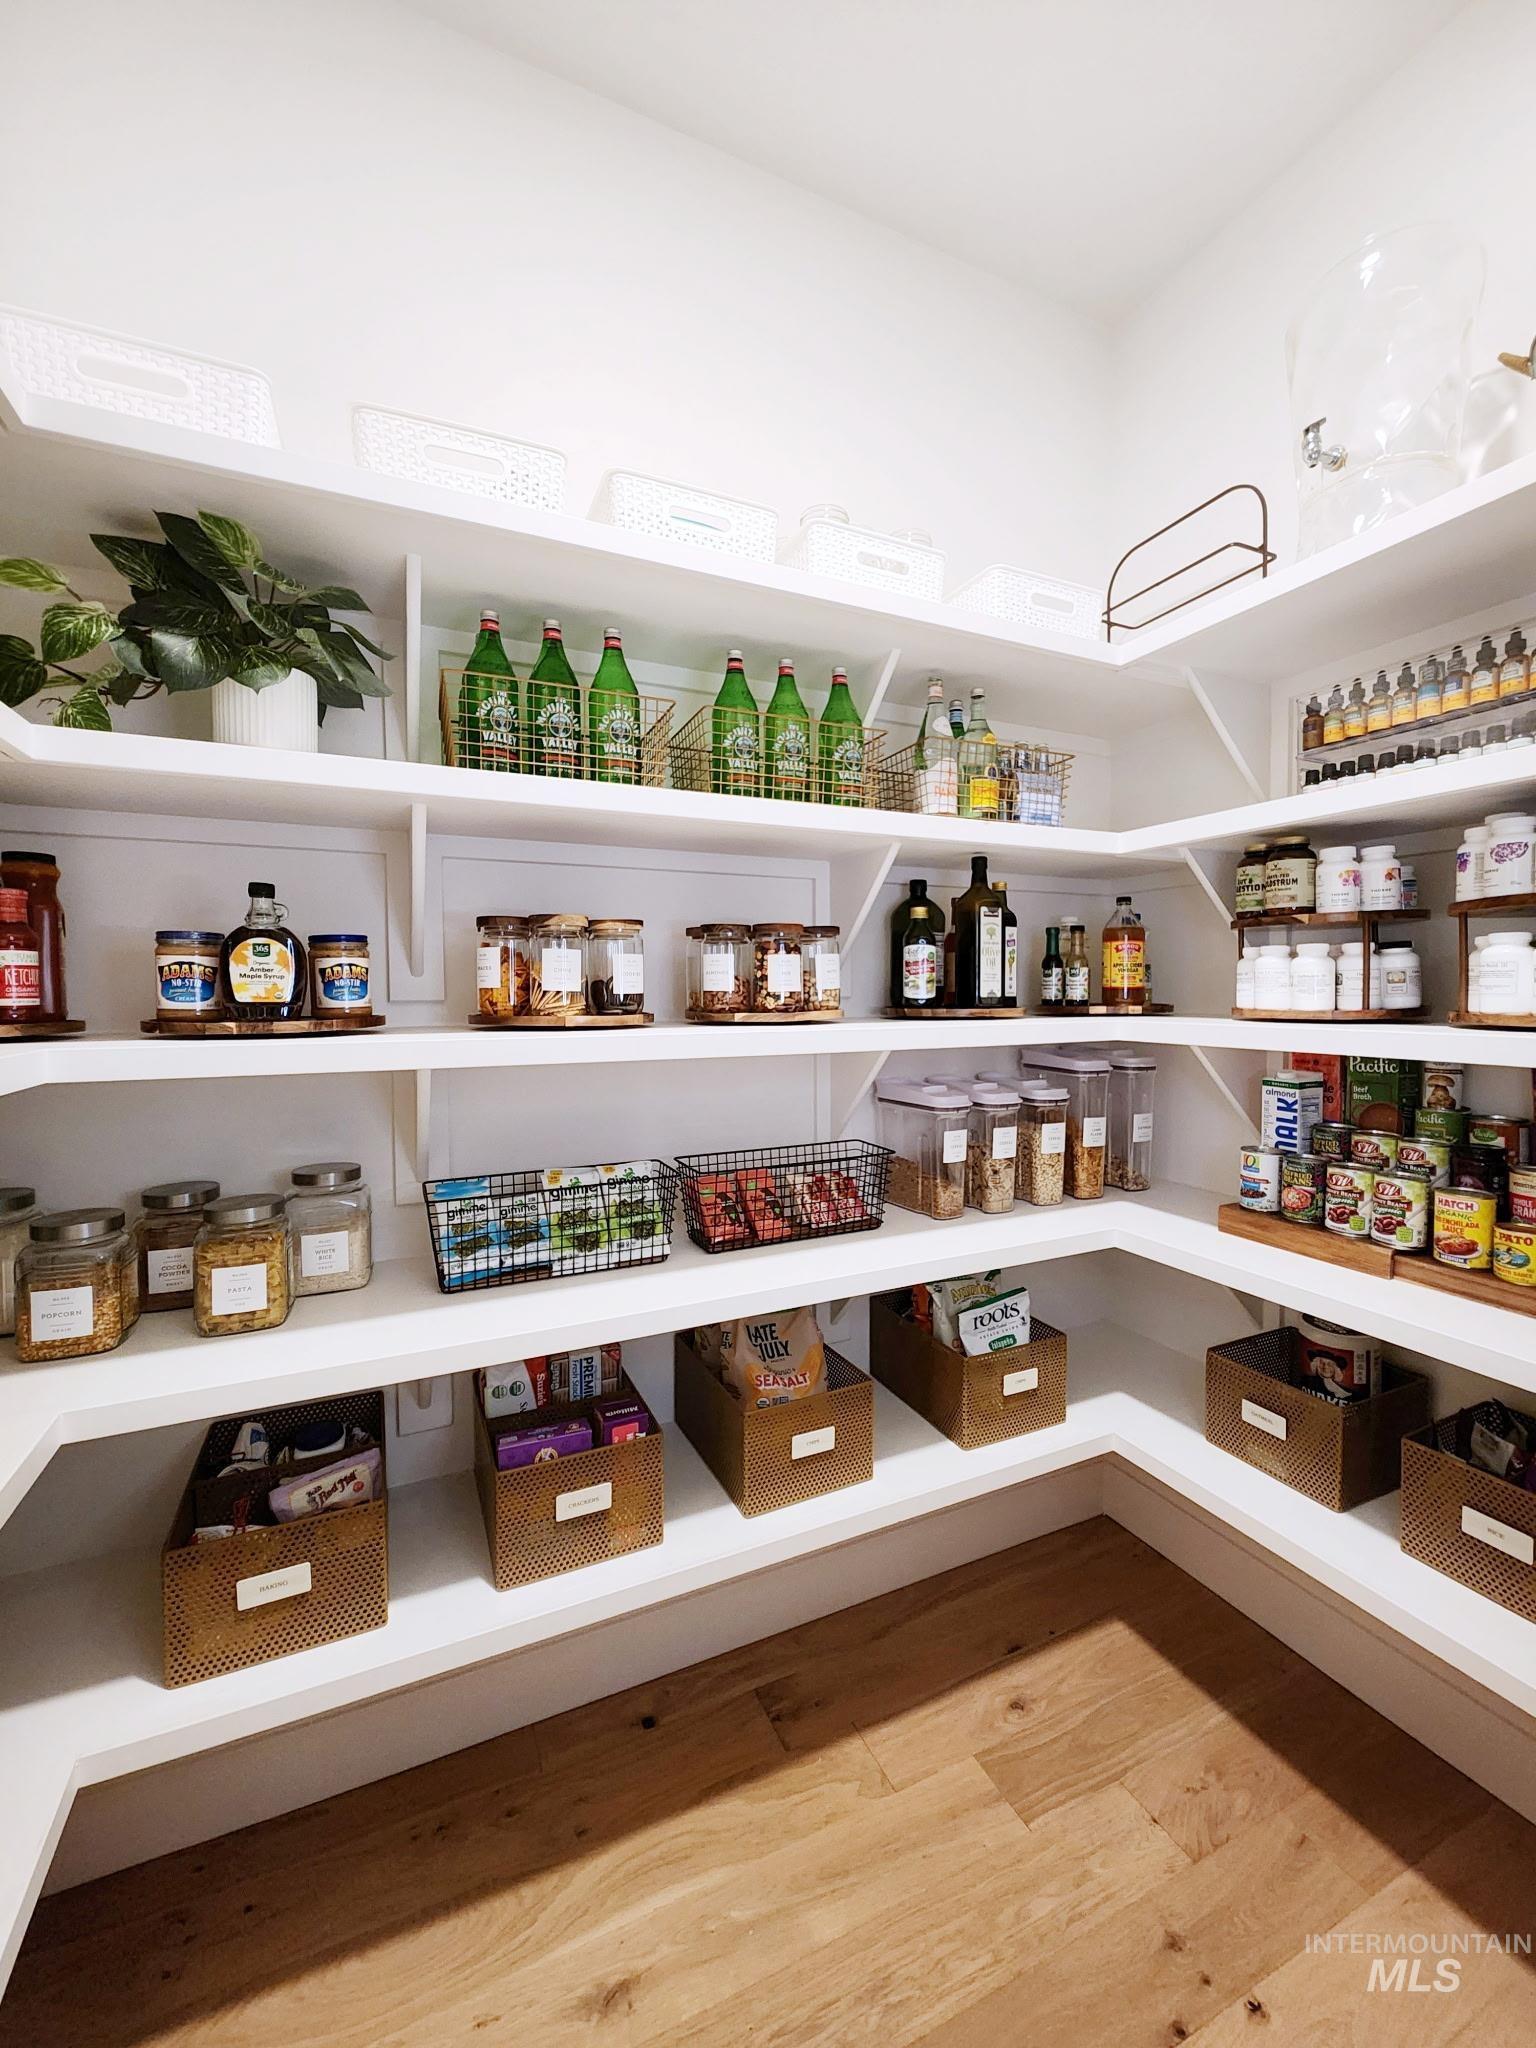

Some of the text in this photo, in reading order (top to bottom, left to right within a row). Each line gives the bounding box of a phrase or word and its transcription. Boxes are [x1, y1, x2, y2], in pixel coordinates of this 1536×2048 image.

[482, 731, 517, 746] VALLEY
[542, 737, 578, 751] VALLEY
[603, 743, 637, 756] VALLEY
[254, 945, 269, 953] 365
[162, 964, 214, 981] ADAMS
[324, 965, 368, 982] ADAMS
[171, 979, 203, 987] NO-STIR
[1350, 1056, 1399, 1074] Pacific
[1265, 1089, 1296, 1098] almond
[1353, 1085, 1368, 1093] Beef
[1353, 1093, 1372, 1101] Broth
[607, 1174, 650, 1189] gimme
[550, 1185, 598, 1202] gimme
[1387, 1200, 1408, 1208] BEANS
[1438, 1198, 1474, 1211] HATCH
[447, 1203, 487, 1221] gimme
[500, 1203, 538, 1219] gimme
[1438, 1209, 1473, 1222] ORGANIC
[1442, 1224, 1465, 1235] SAUCE
[1443, 1217, 1480, 1229] ENCHILADA
[1499, 1232, 1534, 1246] PATO
[314, 1248, 336, 1256] WHITE
[158, 1269, 190, 1278] POWDER
[161, 1264, 187, 1272] COCOA
[227, 1286, 252, 1294] PASTA
[41, 1310, 82, 1319] POPCORN
[973, 1302, 1020, 1330] roots
[746, 1323, 778, 1347] LATE
[758, 1340, 791, 1362] JULY
[755, 1372, 808, 1388] SEA SALT
[318, 1481, 338, 1508] Red
